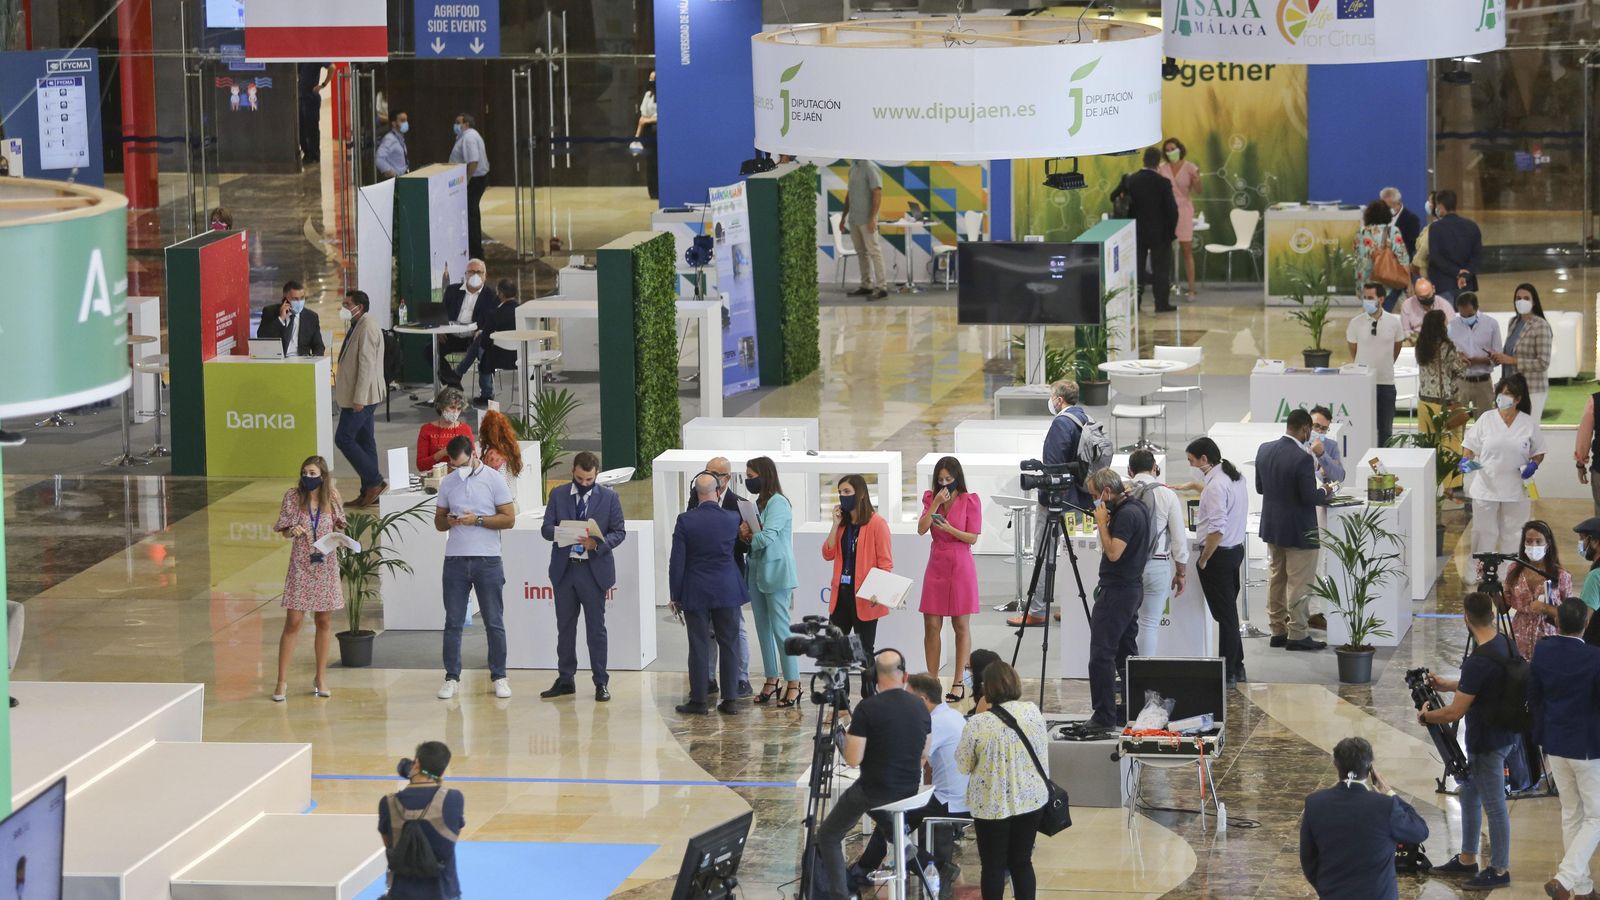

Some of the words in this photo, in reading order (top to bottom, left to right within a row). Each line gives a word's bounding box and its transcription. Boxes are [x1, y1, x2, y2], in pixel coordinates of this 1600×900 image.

[434, 5, 480, 17] AGRIFOOD
[680, 14, 689, 24] DE
[428, 20, 449, 32] SIDE
[451, 20, 487, 32] EVENTS
[1194, 19, 1267, 36] MÁLAGA
[680, 24, 690, 65] UNIVERSIDAD
[1304, 32, 1327, 47] for
[1328, 30, 1376, 47] Citrus
[62, 61, 89, 69] FYCMA
[791, 98, 841, 110] DIPUTACIÓN
[1085, 91, 1134, 105] DIPUTACIÓN
[791, 112, 801, 121] DE
[802, 111, 823, 122] JAÉN
[872, 103, 1037, 124] www.dipujaen.es
[1085, 108, 1098, 118] DE
[1099, 105, 1119, 117] JAÉN
[226, 410, 296, 429] Bankia
